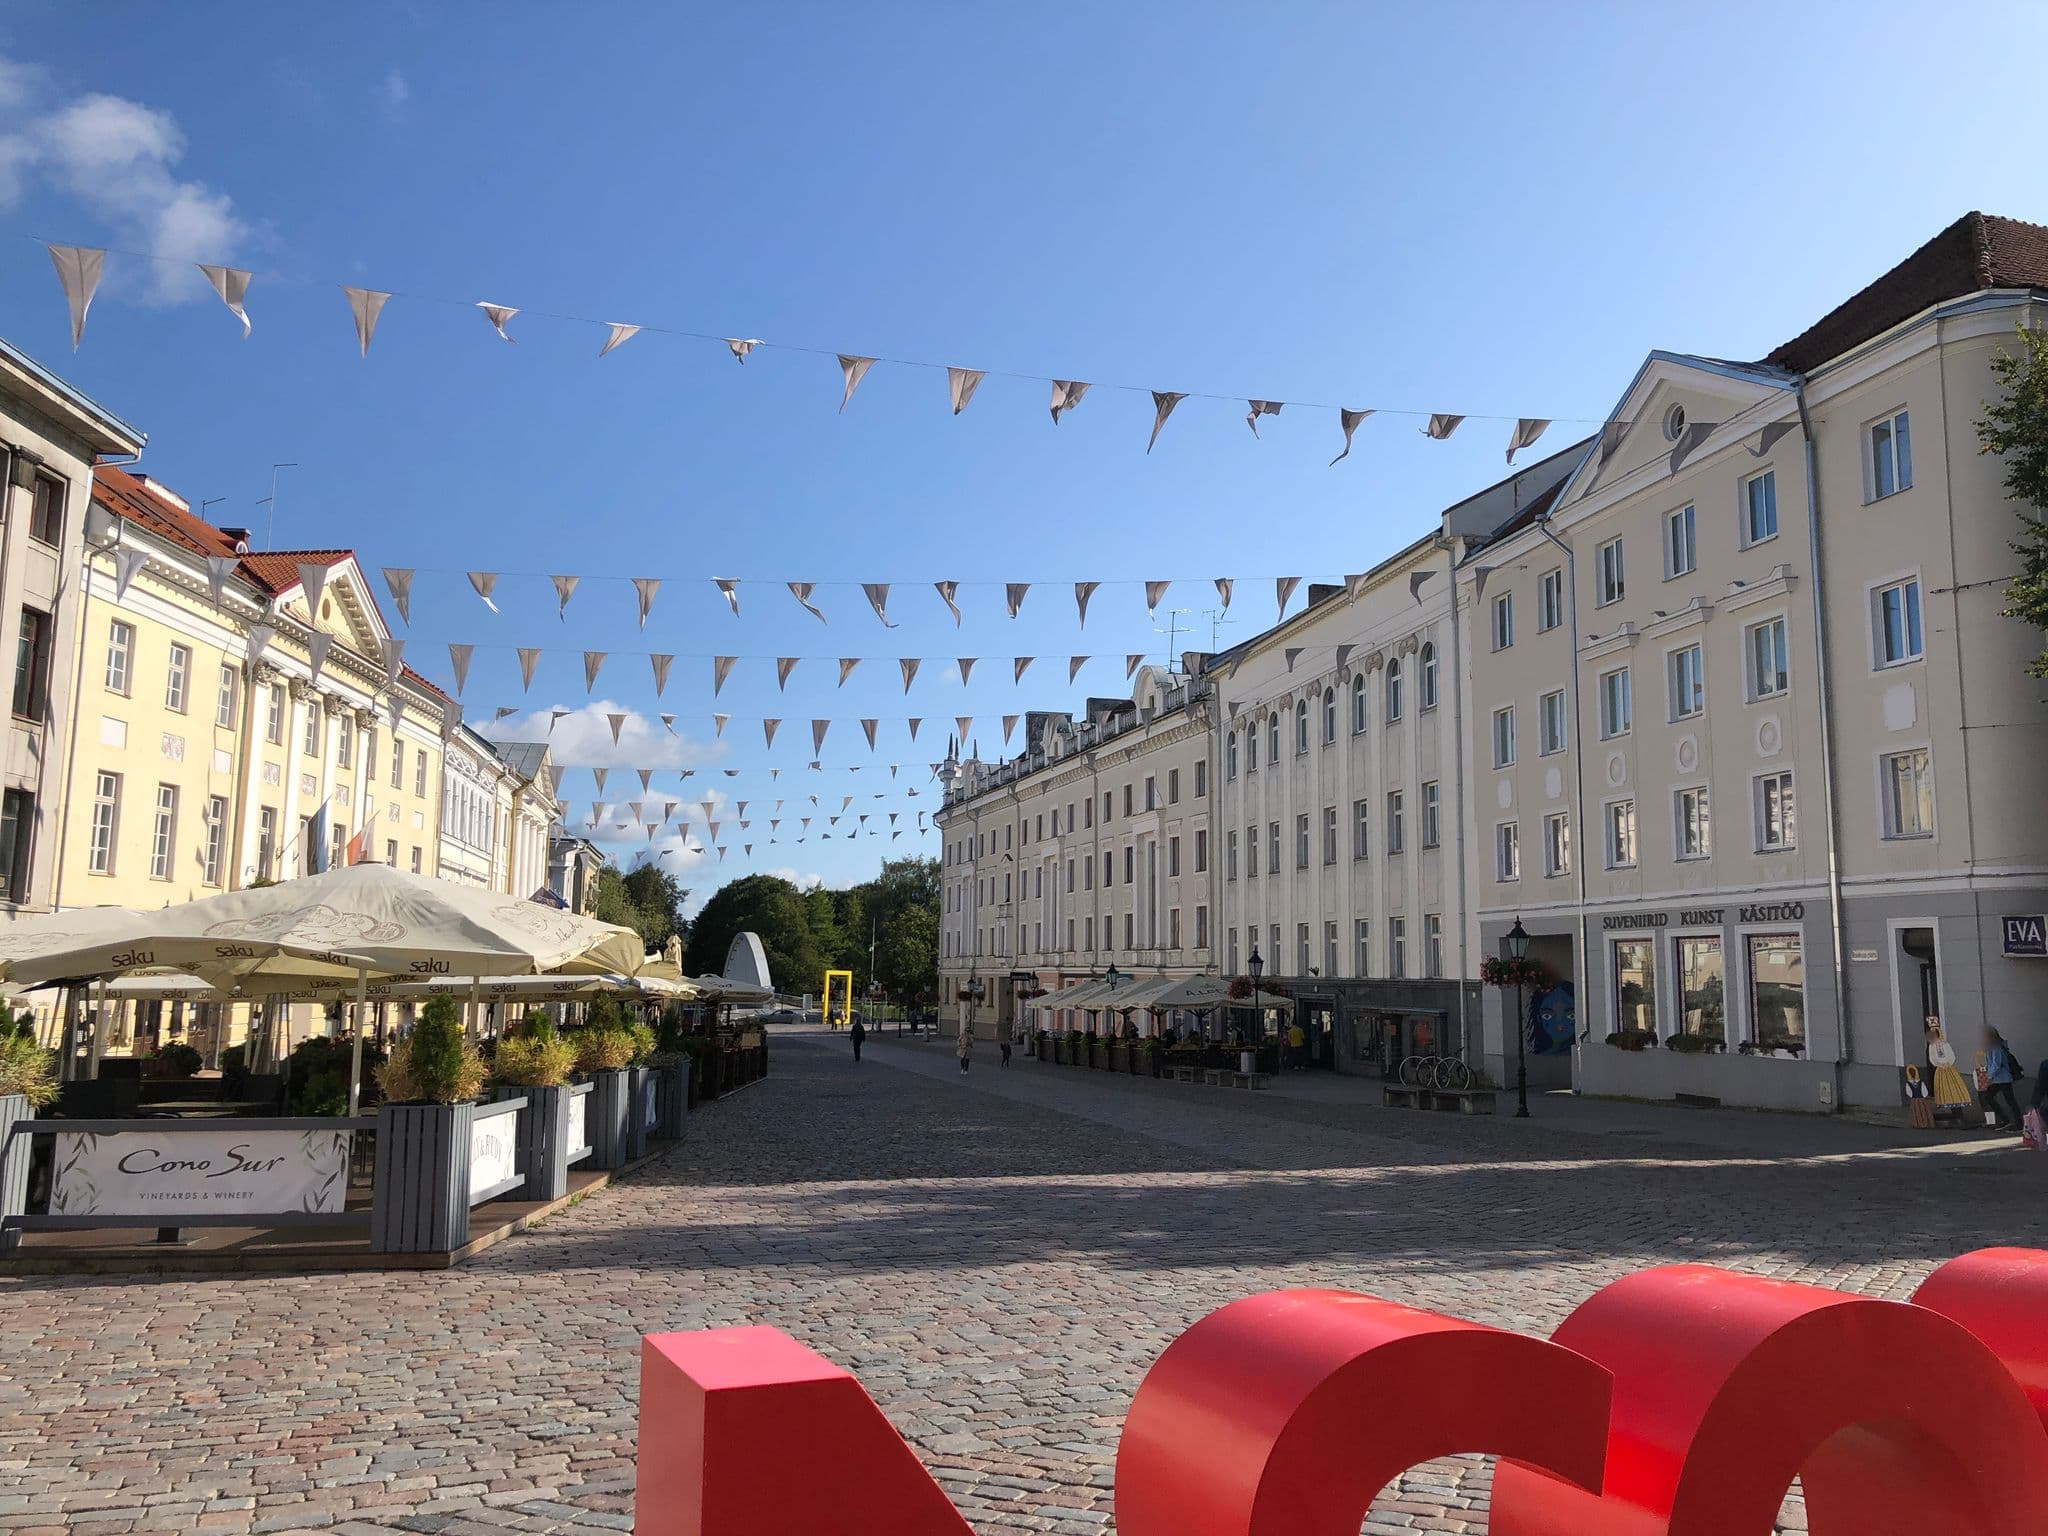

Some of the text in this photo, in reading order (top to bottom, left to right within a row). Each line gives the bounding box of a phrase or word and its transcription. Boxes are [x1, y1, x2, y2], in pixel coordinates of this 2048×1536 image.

[1603, 902, 1805, 929] SUVENIIRID KUNST KÄSITÖÖ
[2007, 920, 2042, 942] EVA
[215, 945, 254, 958] saku
[112, 949, 155, 968] saku
[309, 951, 349, 966] saku
[409, 957, 450, 974] saku
[366, 984, 392, 995] saku
[429, 985, 454, 994] saku
[491, 982, 517, 993] saku
[552, 981, 578, 991] saku
[161, 988, 188, 999] saku
[118, 1144, 285, 1178] Cono Sur
[139, 1191, 255, 1200] VINEYARDS & WINERY
